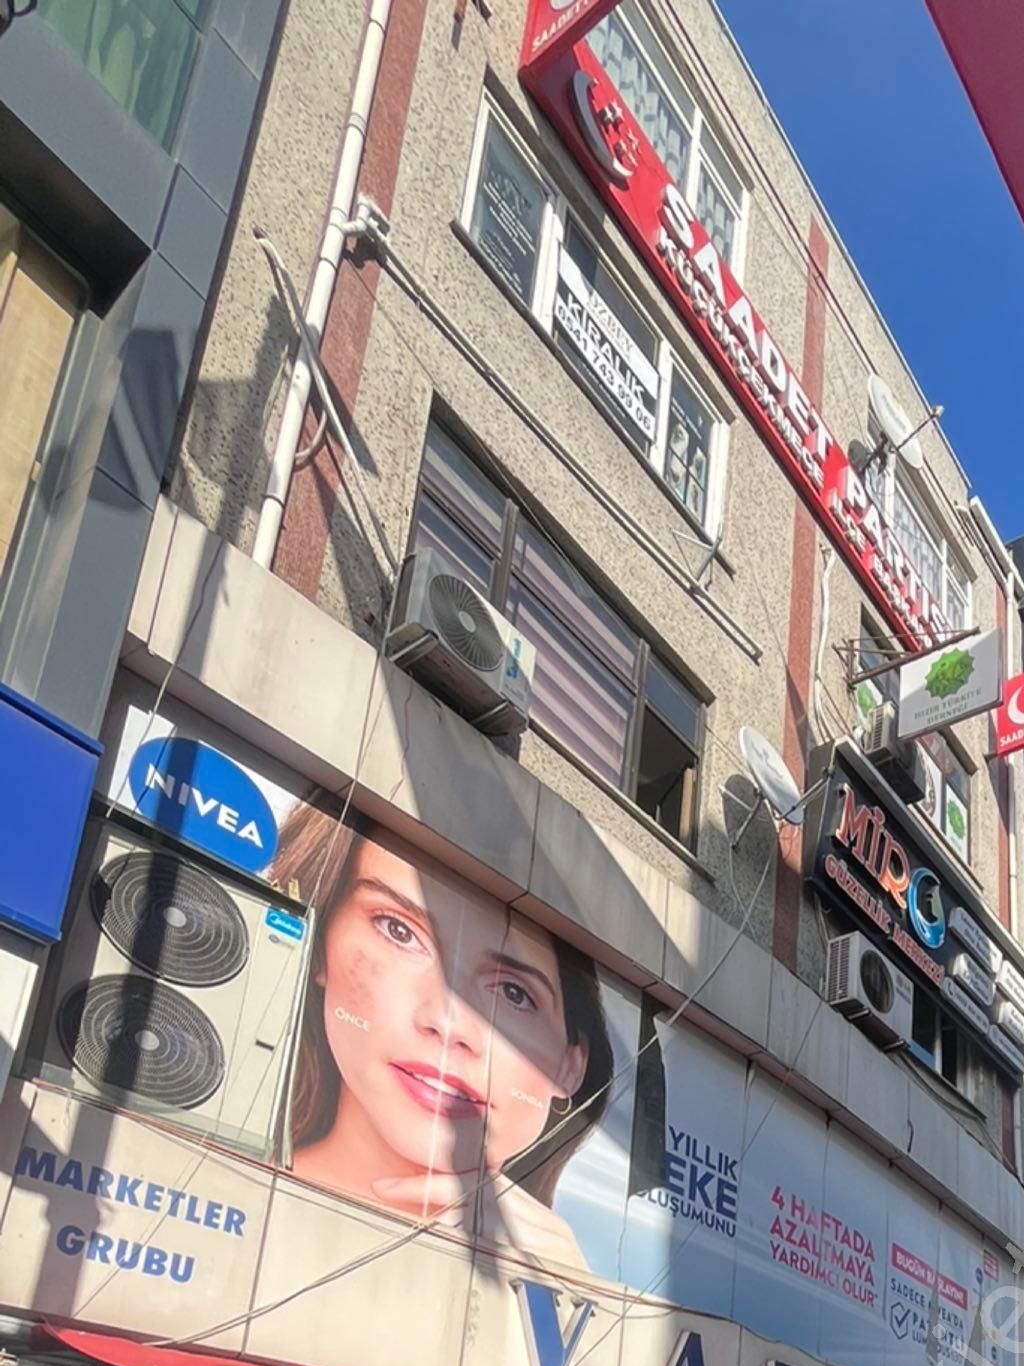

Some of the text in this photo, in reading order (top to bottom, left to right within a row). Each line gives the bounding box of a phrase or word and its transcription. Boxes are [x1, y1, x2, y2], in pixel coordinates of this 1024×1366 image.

[558, 303, 588, 352] 0541
[658, 226, 824, 488] KÜÇÜKÇEKMECE
[664, 183, 833, 462] SAADET
[145, 763, 264, 850] NIVEA
[335, 1005, 372, 1033] ÖNCE
[669, 1127, 739, 1182] YILLIK
[15, 1147, 248, 1238] MARKETLER
[770, 1185, 876, 1263] 4 HAFTADA
[56, 1225, 197, 1284] GRUBU
[770, 1216, 876, 1288] AZALTMAYA
[890, 1278, 927, 1308] SADECE
